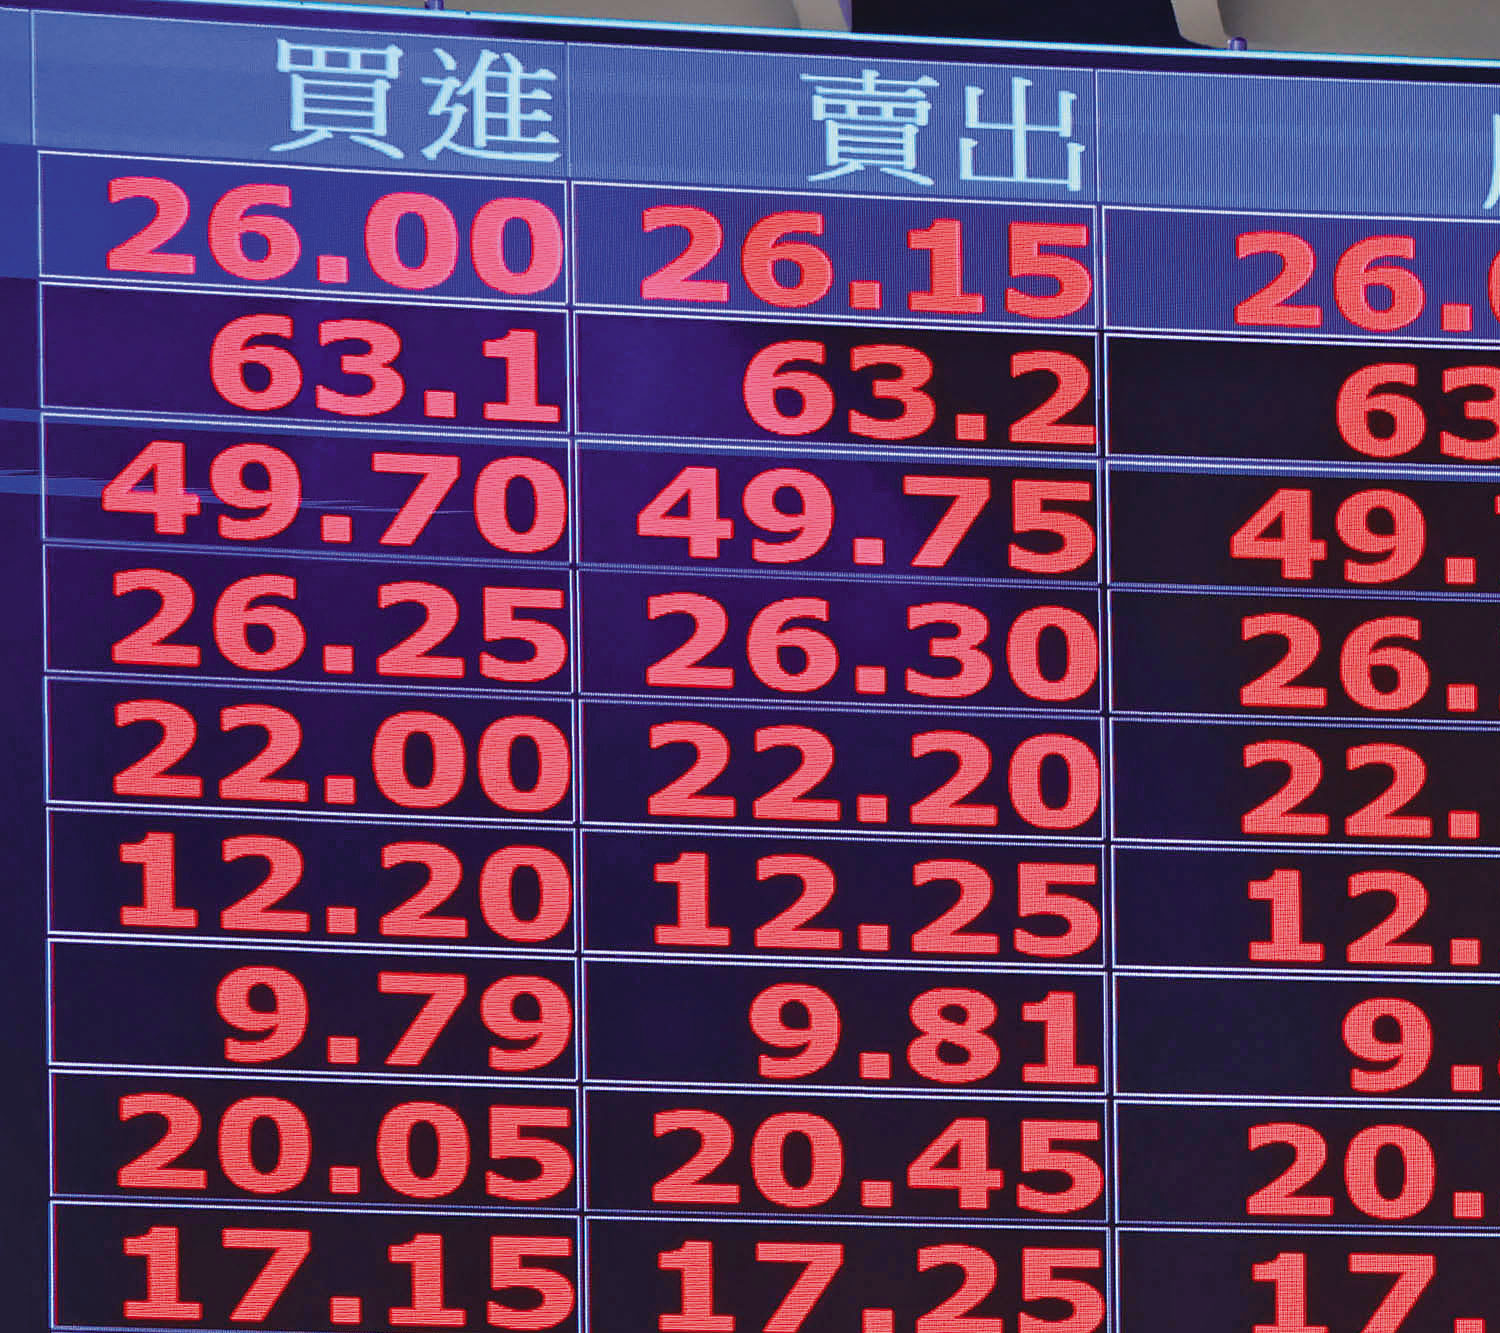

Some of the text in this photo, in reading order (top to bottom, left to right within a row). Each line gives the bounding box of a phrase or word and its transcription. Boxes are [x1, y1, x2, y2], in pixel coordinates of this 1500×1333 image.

[269, 37, 559, 166] 買進
[804, 68, 1085, 194] 賣出
[106, 176, 564, 296] 26.00
[639, 204, 1093, 320] 26.15
[112, 568, 569, 683] 26.25
[645, 591, 1099, 702] 26.30
[119, 831, 573, 943] 12.20
[653, 852, 1101, 958] 12.25
[215, 965, 573, 1072] 9.79
[748, 982, 1099, 1085] 9.81
